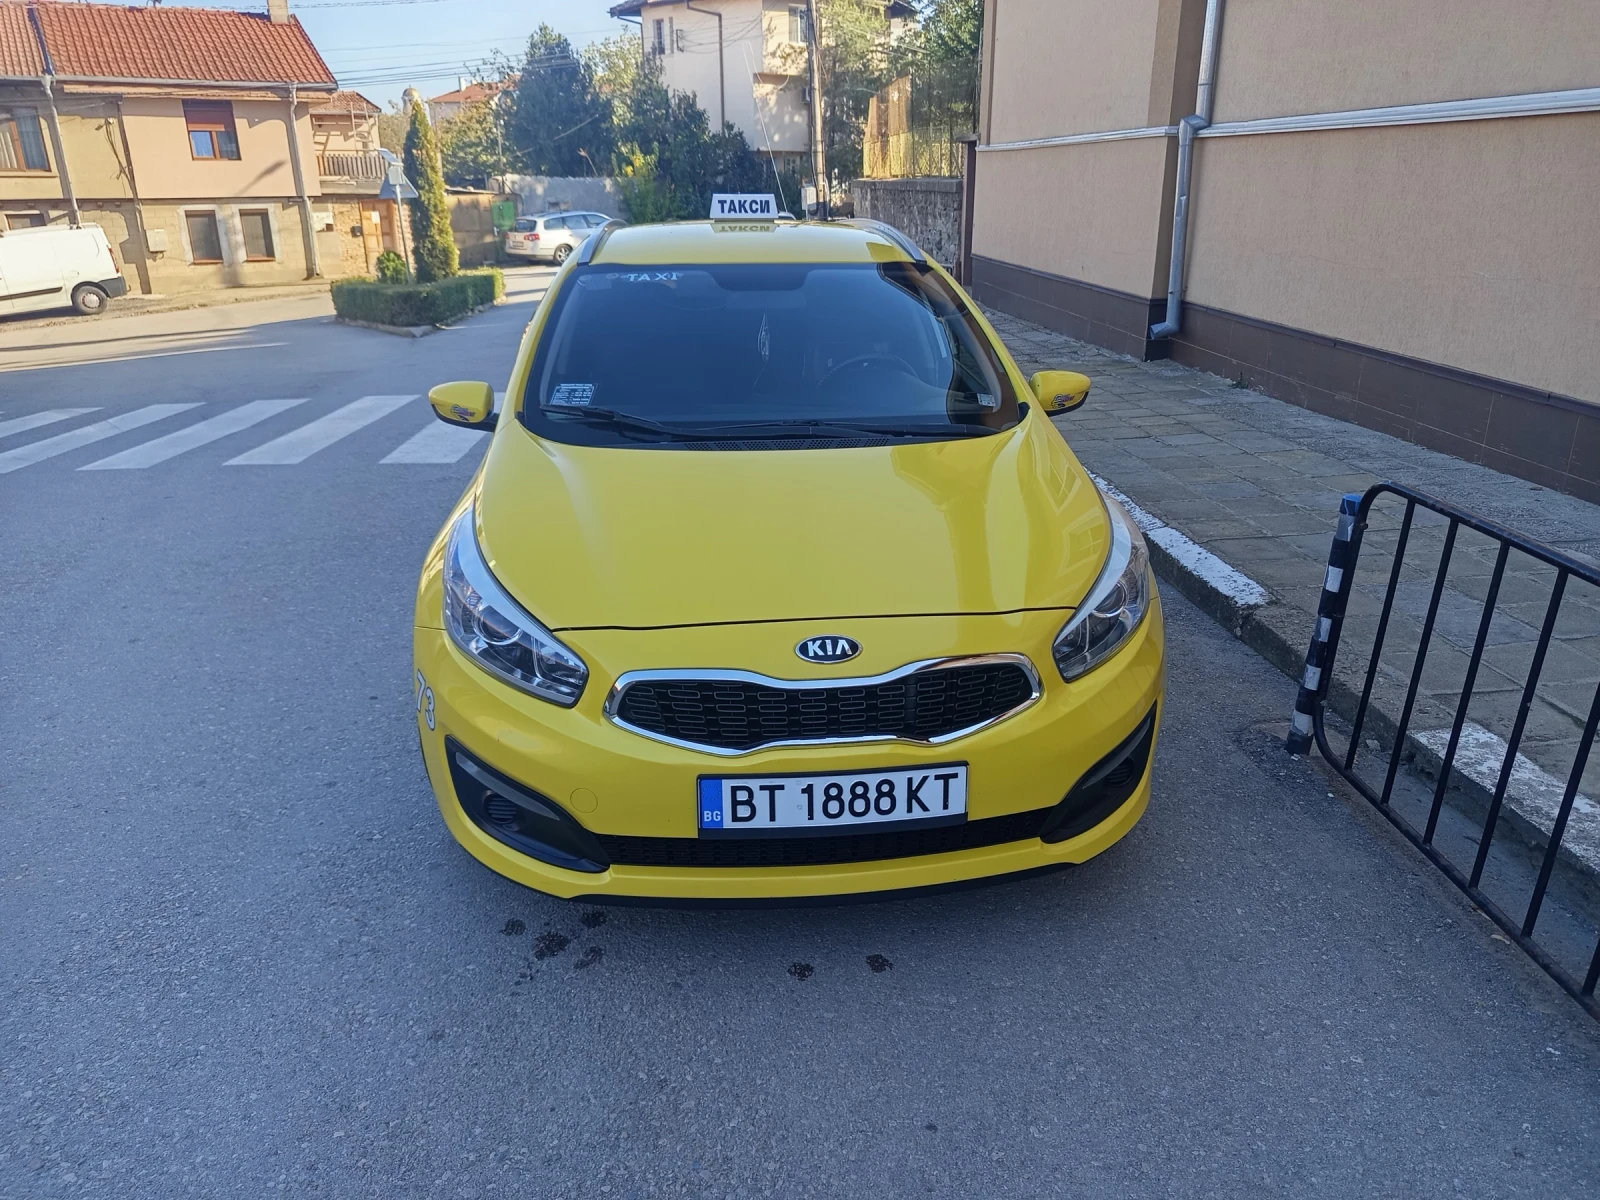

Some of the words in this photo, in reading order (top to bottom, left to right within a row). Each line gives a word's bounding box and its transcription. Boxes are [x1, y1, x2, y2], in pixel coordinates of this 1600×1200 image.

[718, 199, 771, 214] ТАКСИ
[627, 272, 680, 282] TAXI
[806, 639, 853, 657] KIA
[730, 784, 785, 823] BT
[800, 778, 898, 821] 1888
[703, 810, 722, 822] BG
